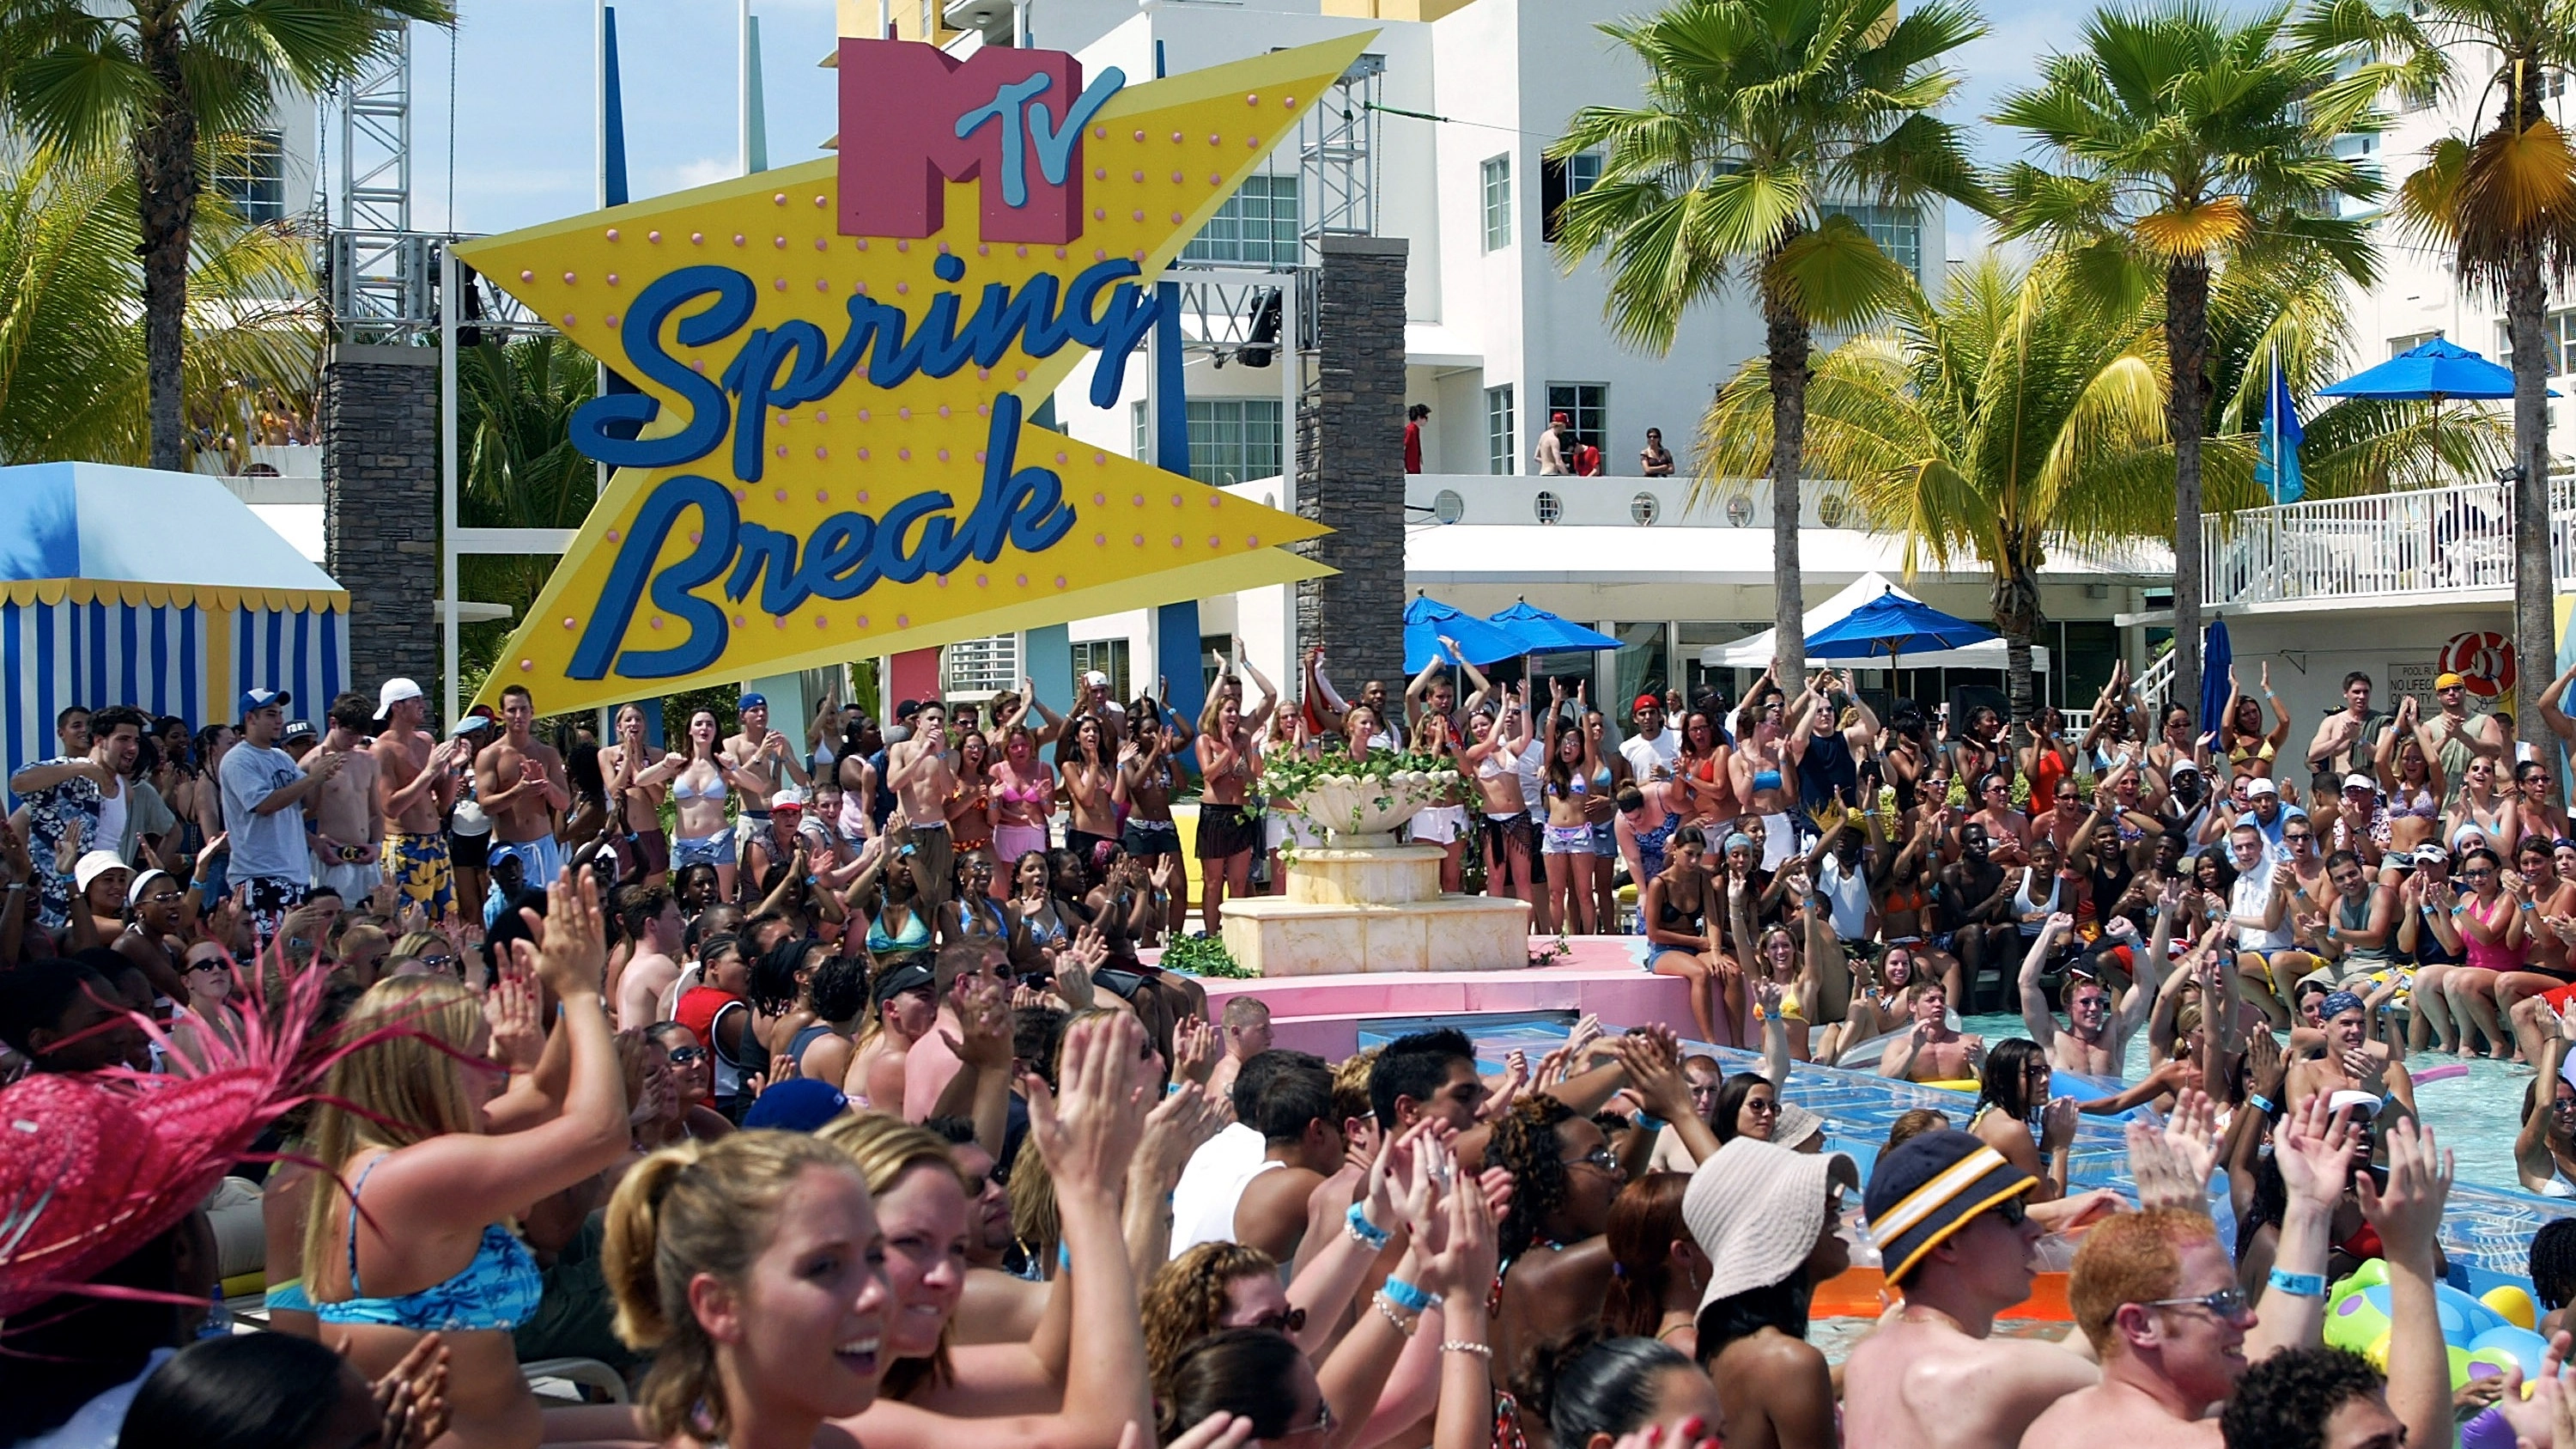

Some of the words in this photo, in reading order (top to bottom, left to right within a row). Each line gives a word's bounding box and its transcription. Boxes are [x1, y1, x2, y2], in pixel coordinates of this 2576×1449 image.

[838, 36, 1126, 244] MTV
[568, 253, 1165, 484] Spring
[564, 393, 1076, 680] Break
[2391, 679, 2404, 691] NO
[2407, 679, 2436, 691] LIFEG
